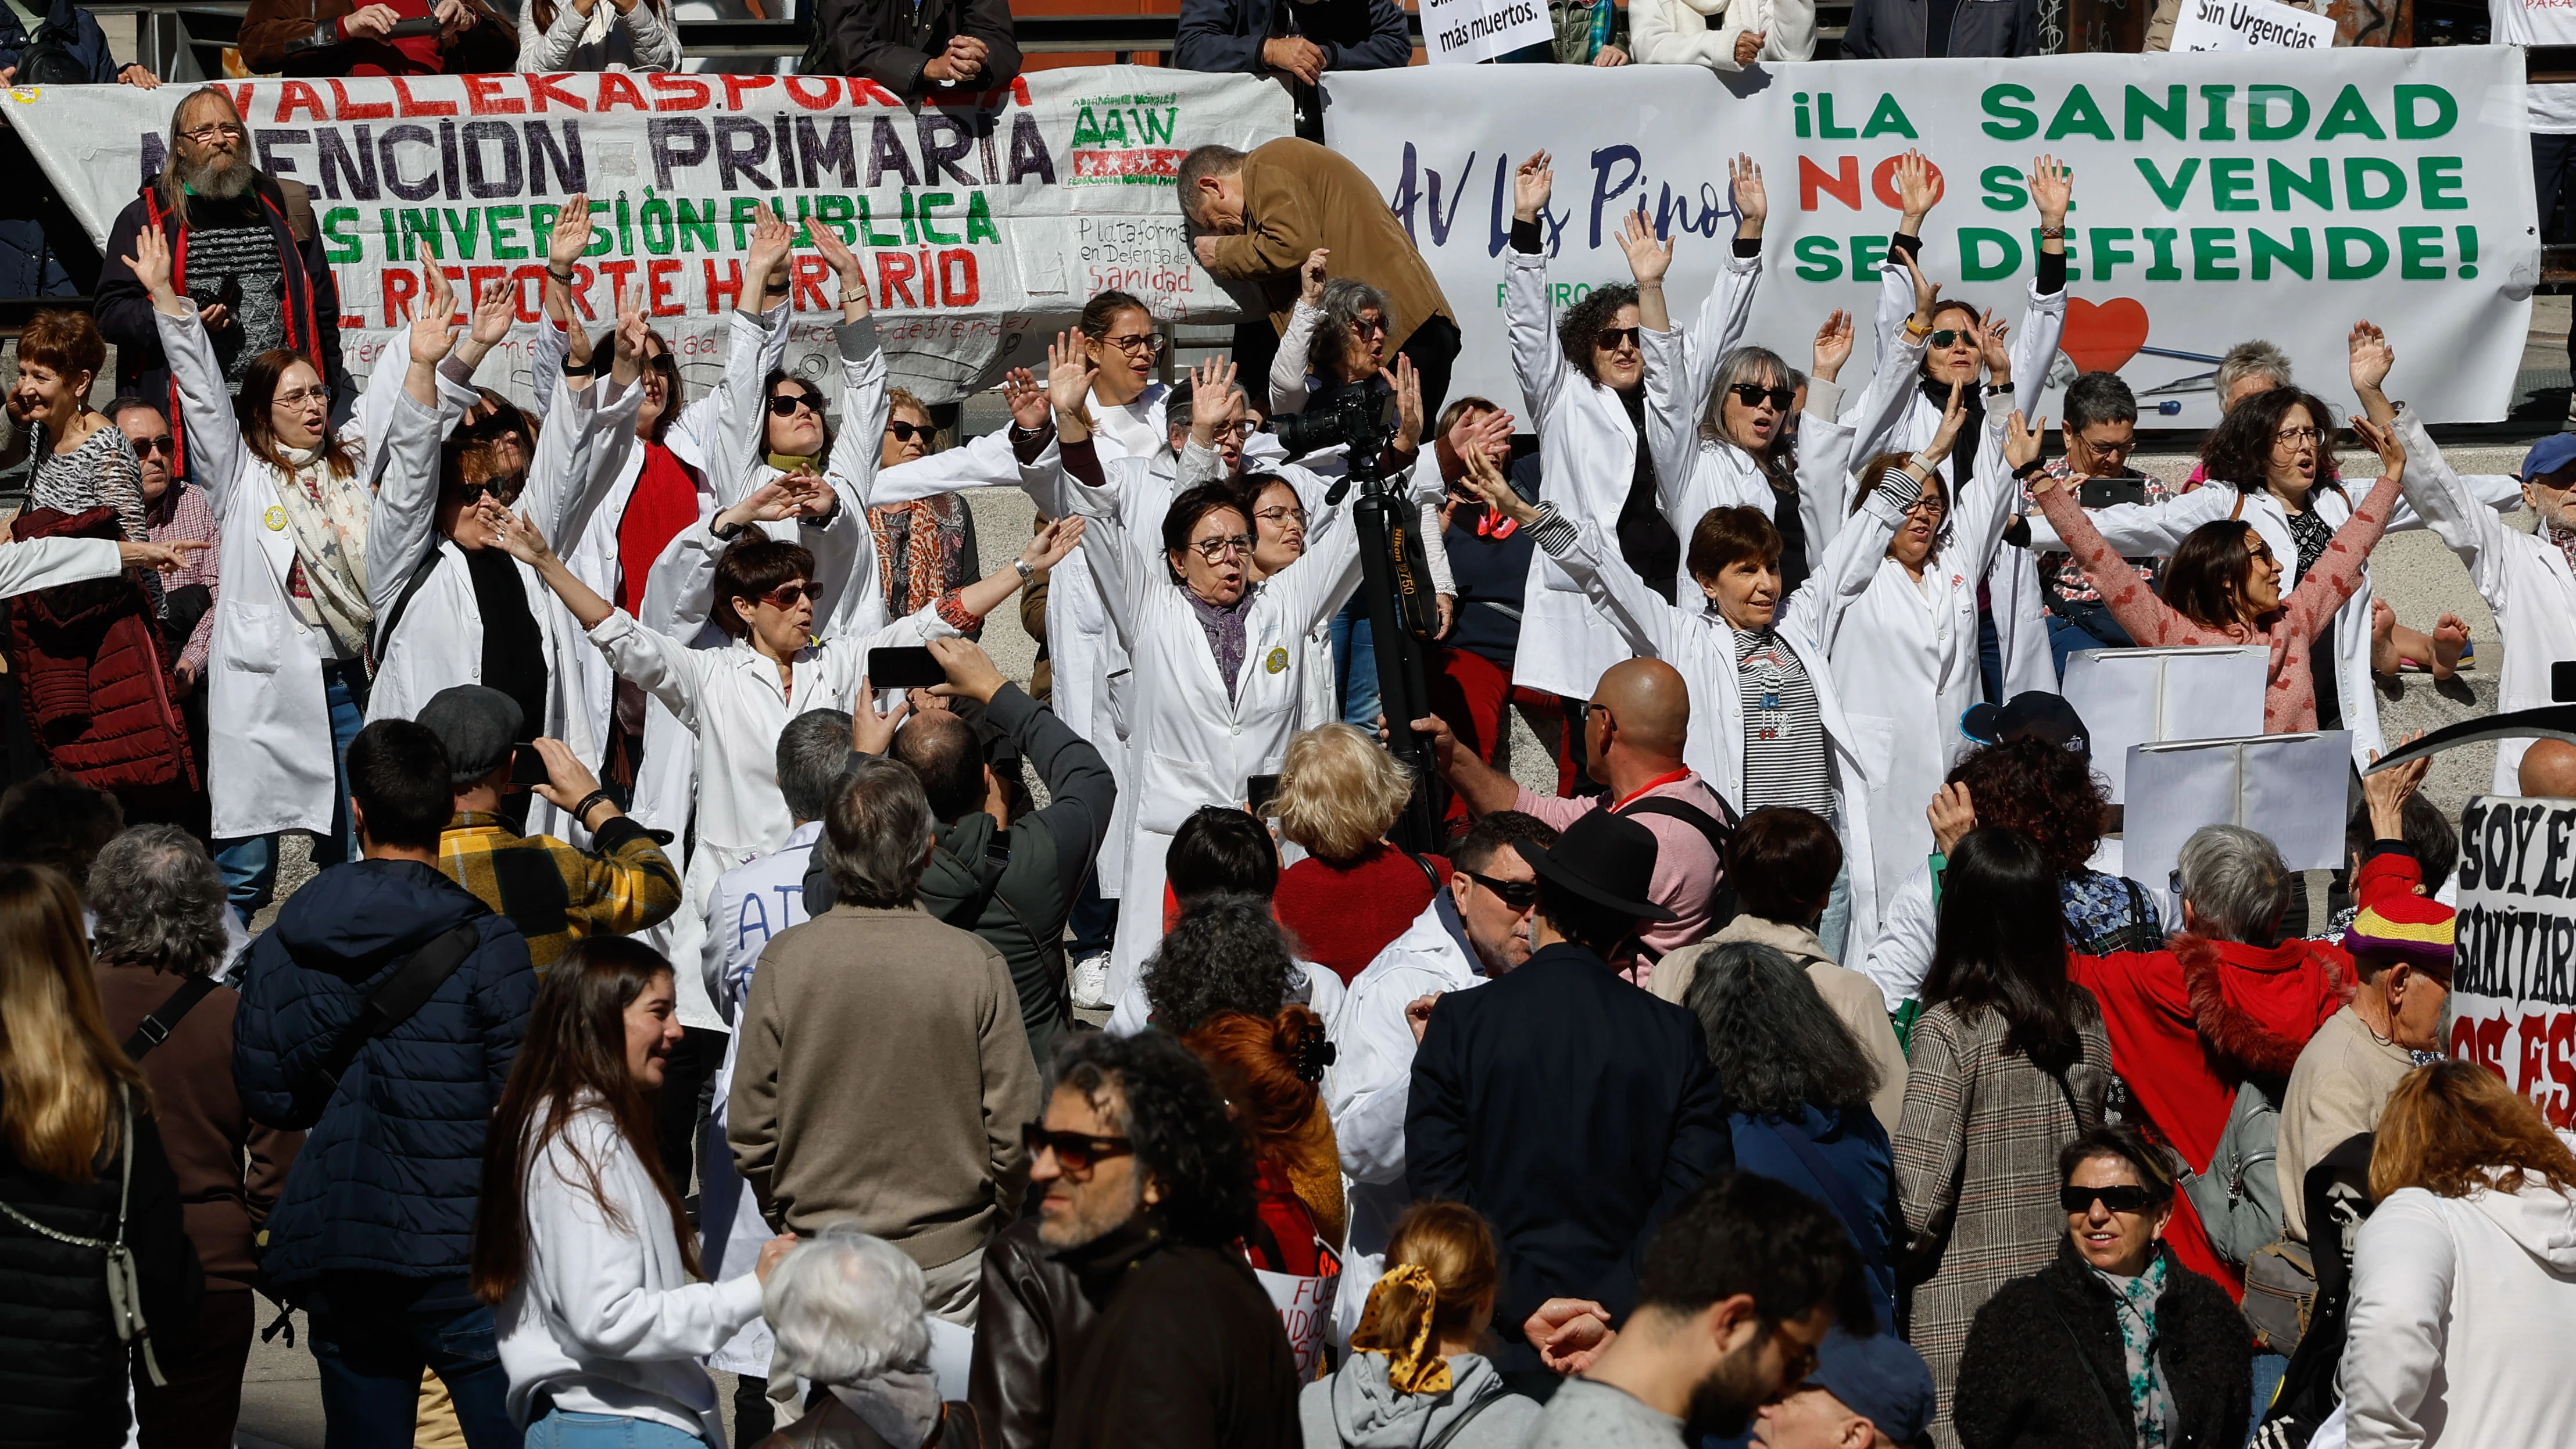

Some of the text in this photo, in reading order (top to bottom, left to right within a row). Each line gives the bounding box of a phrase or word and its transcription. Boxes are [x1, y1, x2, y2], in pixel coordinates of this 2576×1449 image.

[1440, 2, 1539, 52] más muertos.
[2196, 0, 2317, 49] Sin Urgencias
[1981, 83, 2459, 141] SANIDAD
[1798, 154, 1945, 212] NO
[2134, 156, 2468, 212] VENDE
[1079, 218, 1190, 245] Plataforma
[1080, 246, 1100, 260] en
[1103, 244, 1172, 266] Defensa
[1173, 245, 1187, 264] de
[1794, 225, 2479, 282] SE DEFIENDE!
[703, 244, 980, 315] HRRIO
[1394, 528, 1415, 595] Nikon D750
[2459, 803, 2546, 896] SOY
[2453, 901, 2576, 1012] SANITAR
